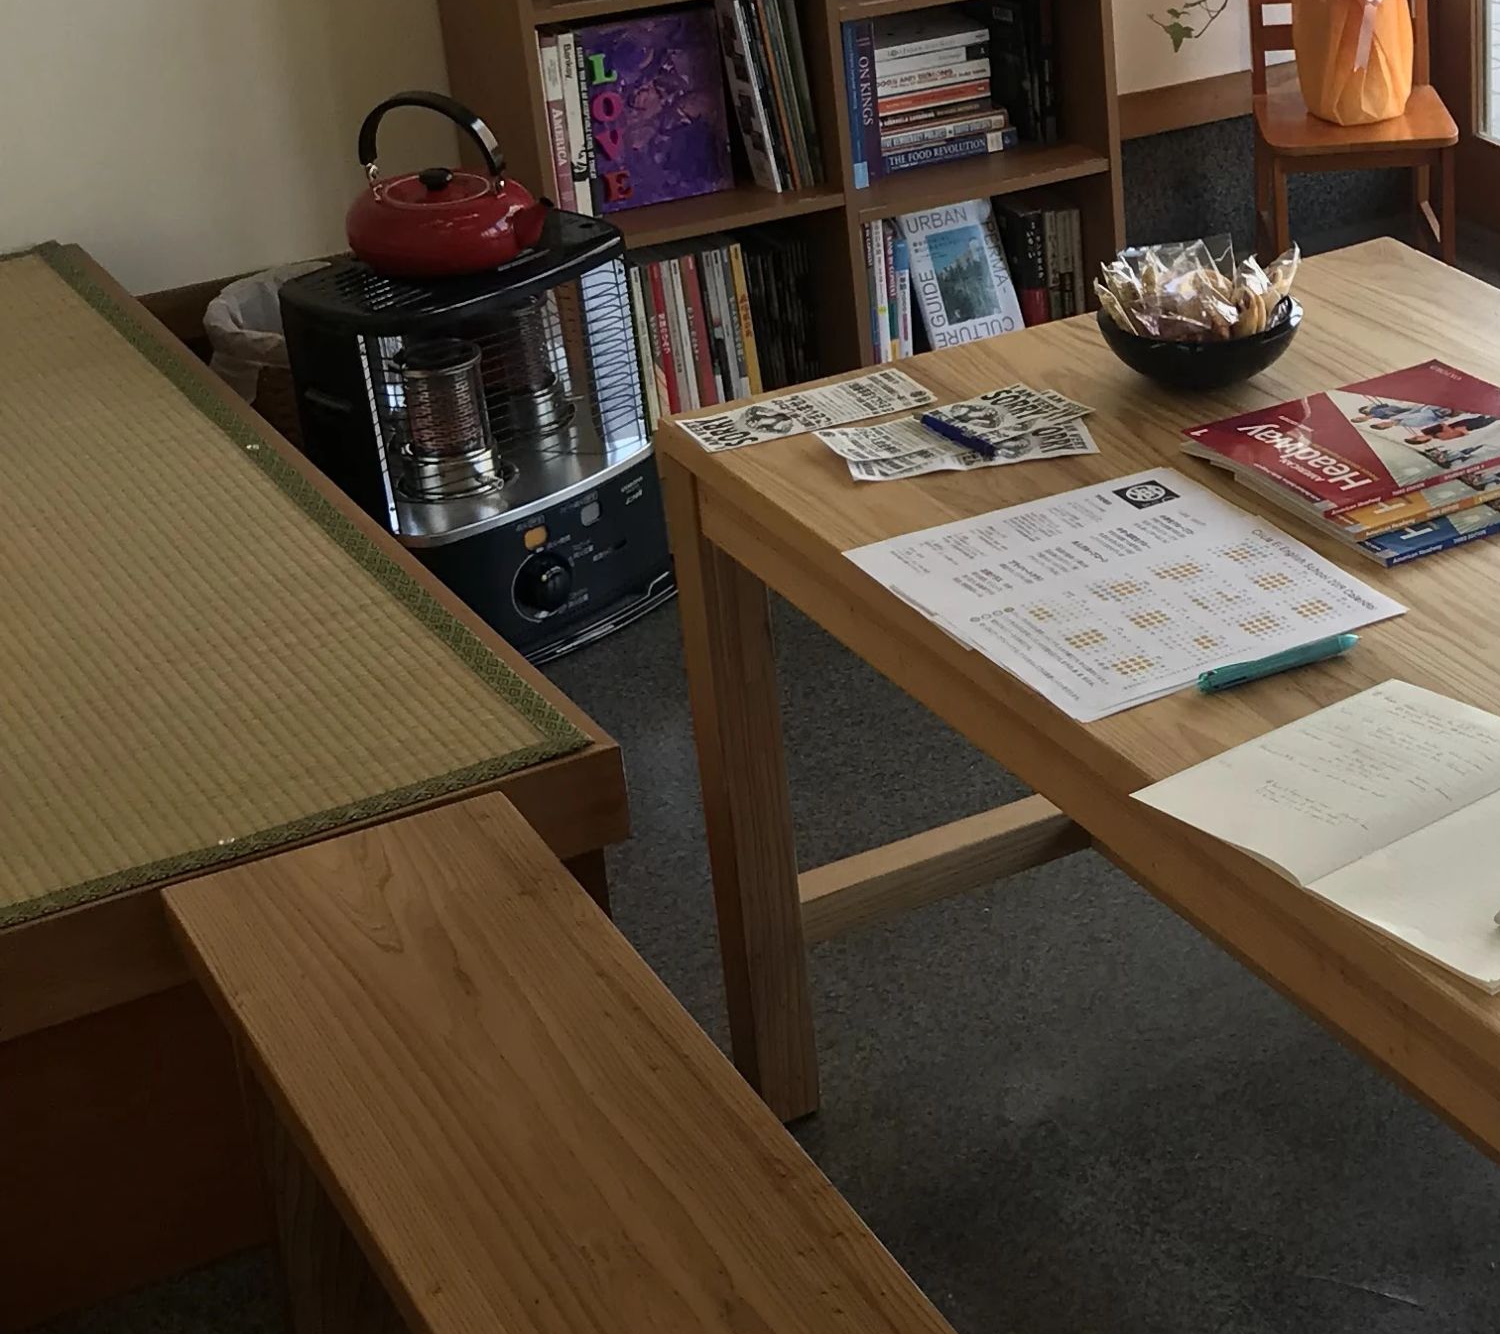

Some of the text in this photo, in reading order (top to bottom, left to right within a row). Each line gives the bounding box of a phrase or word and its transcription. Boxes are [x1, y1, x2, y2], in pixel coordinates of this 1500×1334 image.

[858, 56, 873, 126] ON KINGS
[552, 109, 567, 166] AMERICA
[889, 155, 905, 166] THE
[908, 150, 932, 163] FOOD
[934, 139, 986, 158] REVOLUTION
[906, 207, 967, 233] URBAN
[918, 269, 946, 328] GUIDE
[935, 316, 1015, 348] CULTURE
[980, 389, 1049, 419] SORRY
[695, 416, 758, 447] SORRY
[1031, 427, 1076, 453] ORRY
[1237, 423, 1372, 491] Headway
[1331, 504, 1357, 515] American
[1357, 497, 1382, 507] Headway
[1393, 552, 1418, 564] American
[1419, 544, 1443, 555] Headway
[1468, 530, 1487, 540] EDITION
